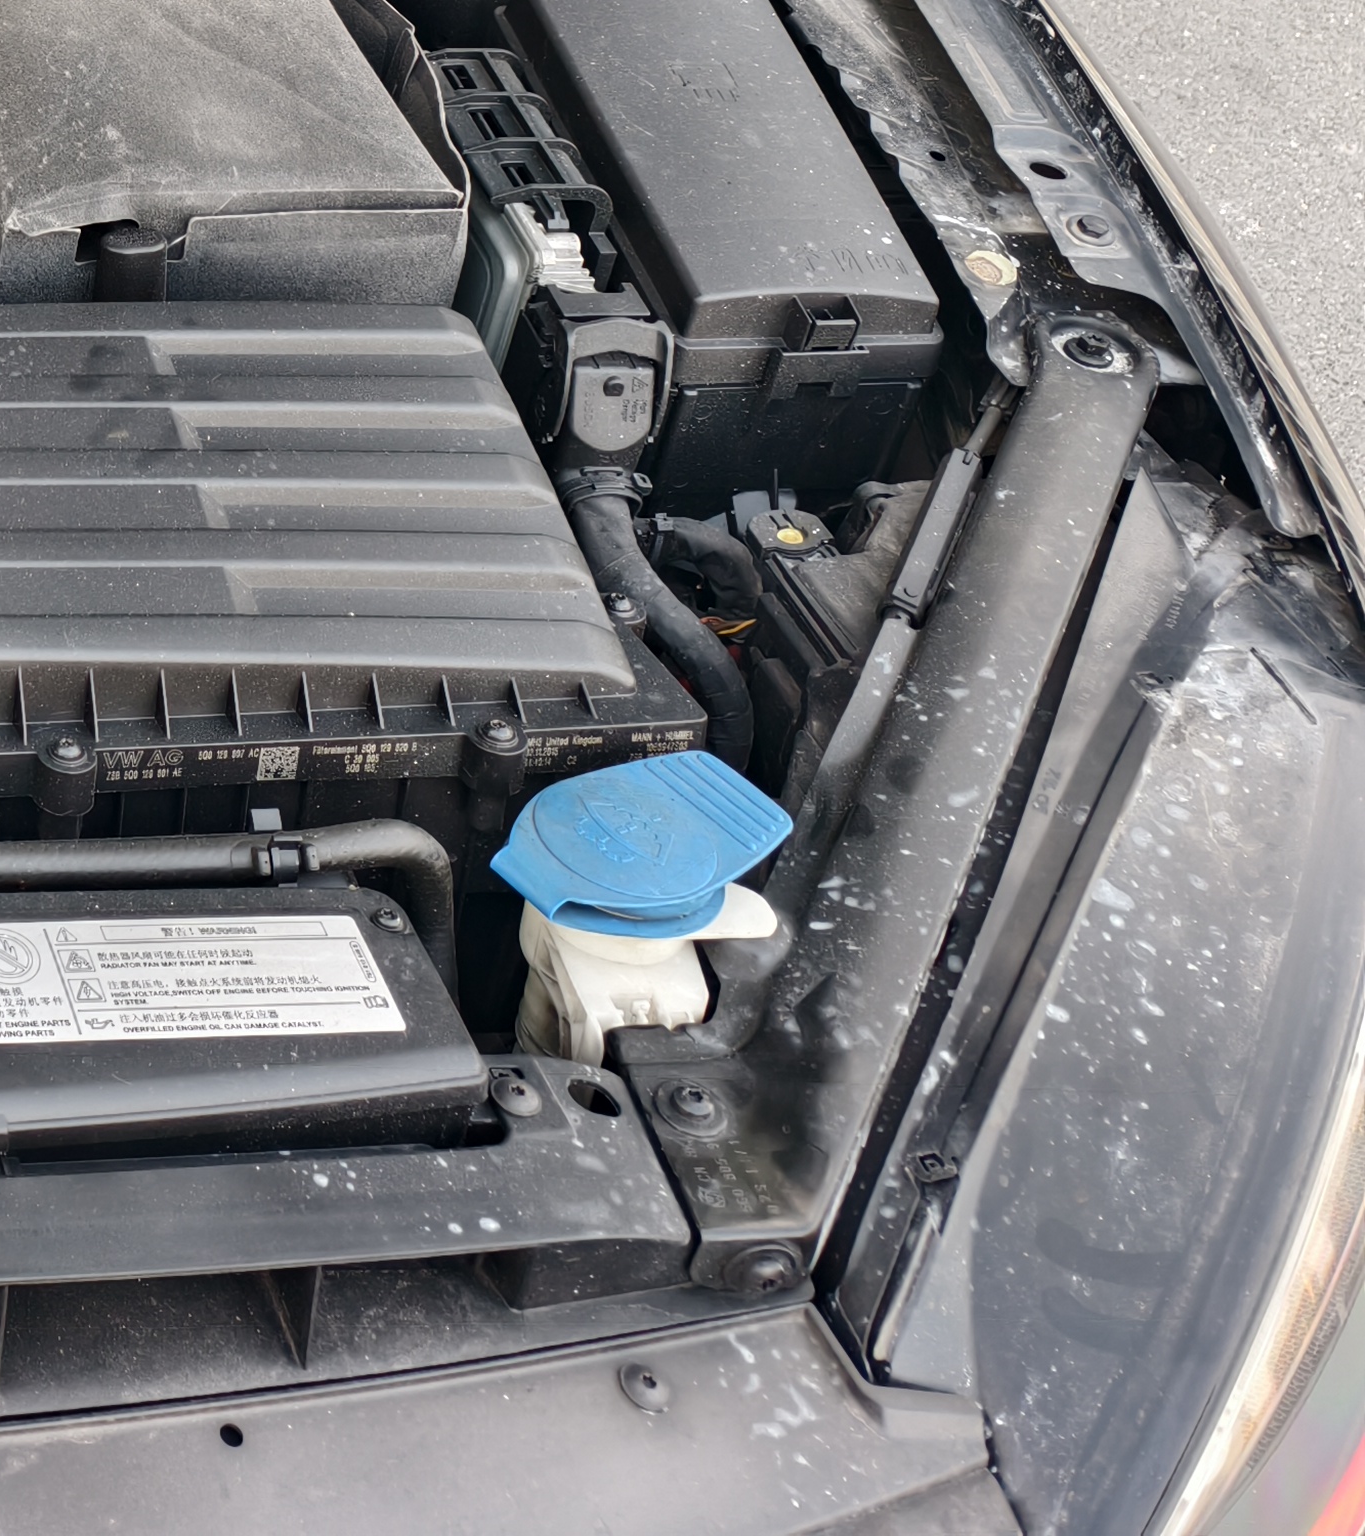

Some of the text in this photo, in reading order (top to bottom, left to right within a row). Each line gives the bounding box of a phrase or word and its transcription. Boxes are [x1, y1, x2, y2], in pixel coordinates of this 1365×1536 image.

[546, 737, 568, 746] United
[572, 735, 603, 747] Kingdom
[632, 732, 652, 742] MANN
[103, 749, 184, 768] VW AG
[172, 767, 183, 777] AE
[5, 1020, 40, 1028] ENGINE
[41, 1019, 71, 1027] PARTS
[123, 1025, 174, 1033] OVERFILLED
[176, 1024, 207, 1032] ENGINE
[25, 1029, 55, 1037] PARTS
